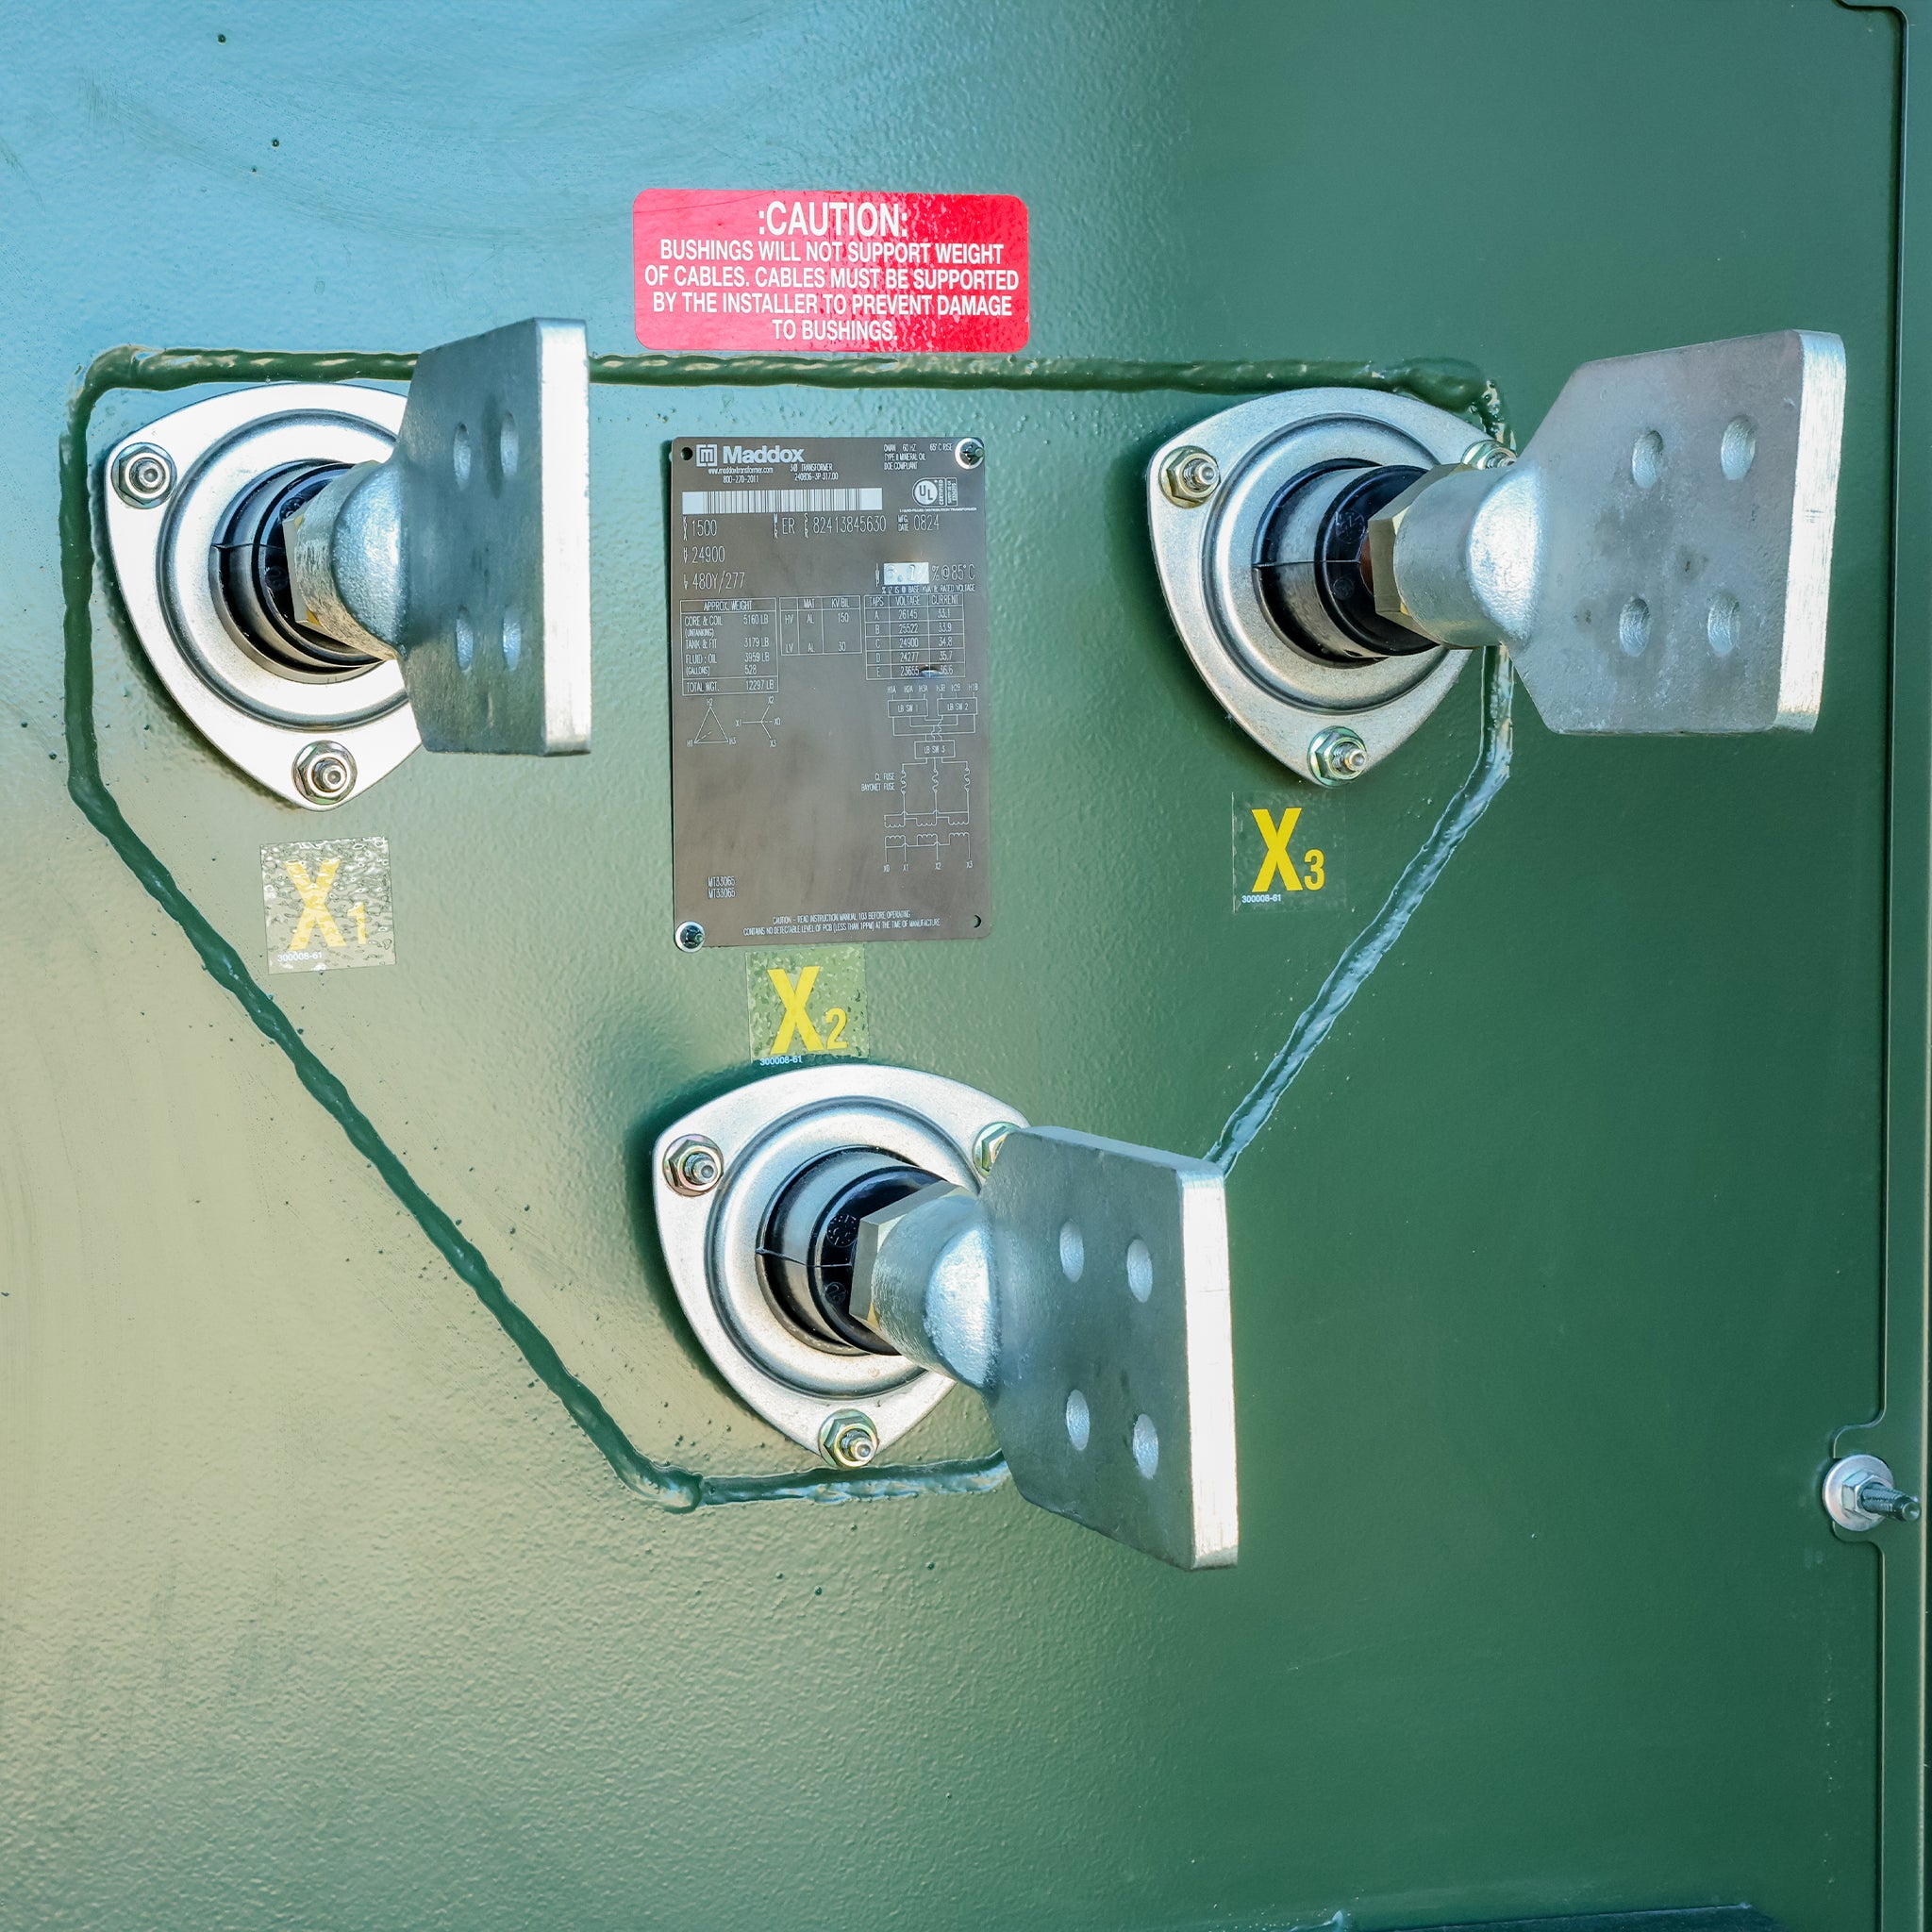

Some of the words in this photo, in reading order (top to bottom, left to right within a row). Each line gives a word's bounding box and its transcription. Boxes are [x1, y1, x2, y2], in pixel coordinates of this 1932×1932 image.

[660, 239, 754, 261] BUSHINGS
[758, 241, 801, 262] WILL
[807, 242, 842, 262] NOT
[847, 242, 931, 263] SUPPORT
[935, 243, 1004, 264] WEIGHT
[644, 265, 669, 286] OF
[674, 266, 749, 287] CABLES.
[756, 267, 825, 288] CABLES
[830, 268, 881, 290] MUST
[886, 268, 908, 289] BE
[913, 269, 1019, 291] SUPPORTED
[653, 291, 676, 312] BY
[682, 291, 717, 313] THE
[723, 292, 818, 313] INSTALLER
[823, 294, 847, 314] TO
[852, 294, 932, 315] PREVENT
[937, 295, 1012, 316] DAMAGE
[772, 319, 796, 340] TO
[802, 320, 897, 341] BUSHINGS.
[723, 445, 805, 464] Maddox
[802, 463, 832, 472] TRANSFORMER
[894, 461, 918, 470] COMPLIANT
[782, 517, 795, 534] ER
[813, 515, 886, 534] 82413845630
[914, 514, 939, 530] 0824
[692, 519, 717, 537] 1500
[692, 545, 724, 563] 24900
[692, 571, 745, 594] 480Y/277
[731, 601, 753, 610] WEIGHT
[896, 596, 920, 606] VOLTAGE
[932, 595, 958, 605] CURRENT
[838, 612, 849, 623] 150
[874, 609, 879, 620] A
[898, 608, 918, 619] 26145
[938, 608, 950, 618] 33.1
[685, 616, 701, 626] CORE
[703, 616, 708, 626] &
[709, 615, 723, 625] COIL
[760, 614, 769, 625] LB
[785, 614, 793, 625] HV
[808, 614, 814, 624] AL
[875, 625, 880, 634] B
[686, 640, 700, 649] TANK
[743, 638, 759, 647] 3179
[761, 637, 769, 647] LB
[808, 642, 815, 653] AL
[839, 641, 846, 651] 30
[875, 639, 880, 648] C
[900, 638, 919, 648] 24900
[786, 643, 793, 653] LV
[686, 654, 702, 664] FLUID
[708, 653, 717, 663] OIL
[744, 652, 760, 662] 3959
[762, 652, 770, 662] LB
[875, 653, 880, 662] D
[745, 664, 757, 675] 528
[876, 667, 880, 676] E
[901, 666, 920, 676] 23655
[687, 683, 704, 692] TOTAL
[706, 682, 720, 691] WGT.
[746, 681, 765, 691] 12297
[766, 679, 774, 690] LB
[965, 702, 969, 710] 2
[884, 773, 895, 781] FUSE
[1251, 807, 1325, 892] X3
[284, 858, 368, 950] X1
[1241, 893, 1281, 904] 300008-61
[773, 916, 791, 924] CAUTION
[810, 913, 839, 923] INSTRUCTION
[868, 911, 887, 920] BEFORE
[774, 925, 800, 935] DETECTABLE
[802, 924, 815, 933] LEVEL
[277, 951, 323, 962] 300008-61
[767, 966, 848, 1055] X2
[759, 1055, 803, 1066] 300008-61
